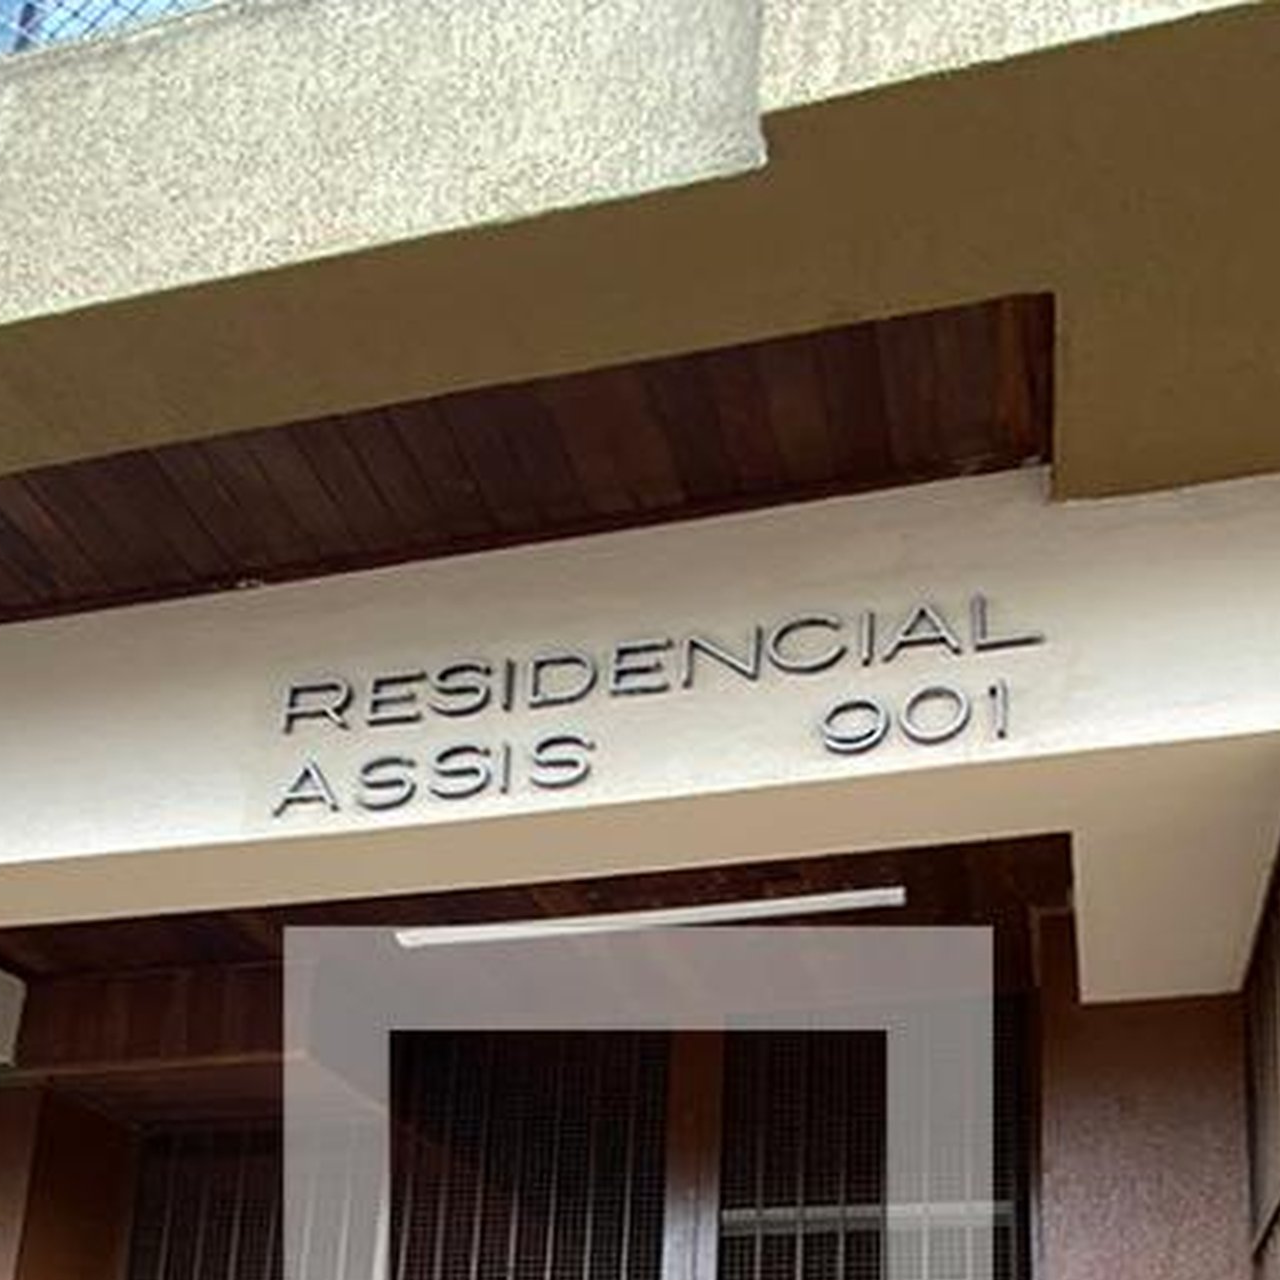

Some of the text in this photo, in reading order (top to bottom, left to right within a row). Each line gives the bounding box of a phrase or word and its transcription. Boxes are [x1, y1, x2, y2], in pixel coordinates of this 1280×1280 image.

[282, 593, 1045, 735] RESIDENCIAL
[272, 678, 1012, 819] ASSIS 901
